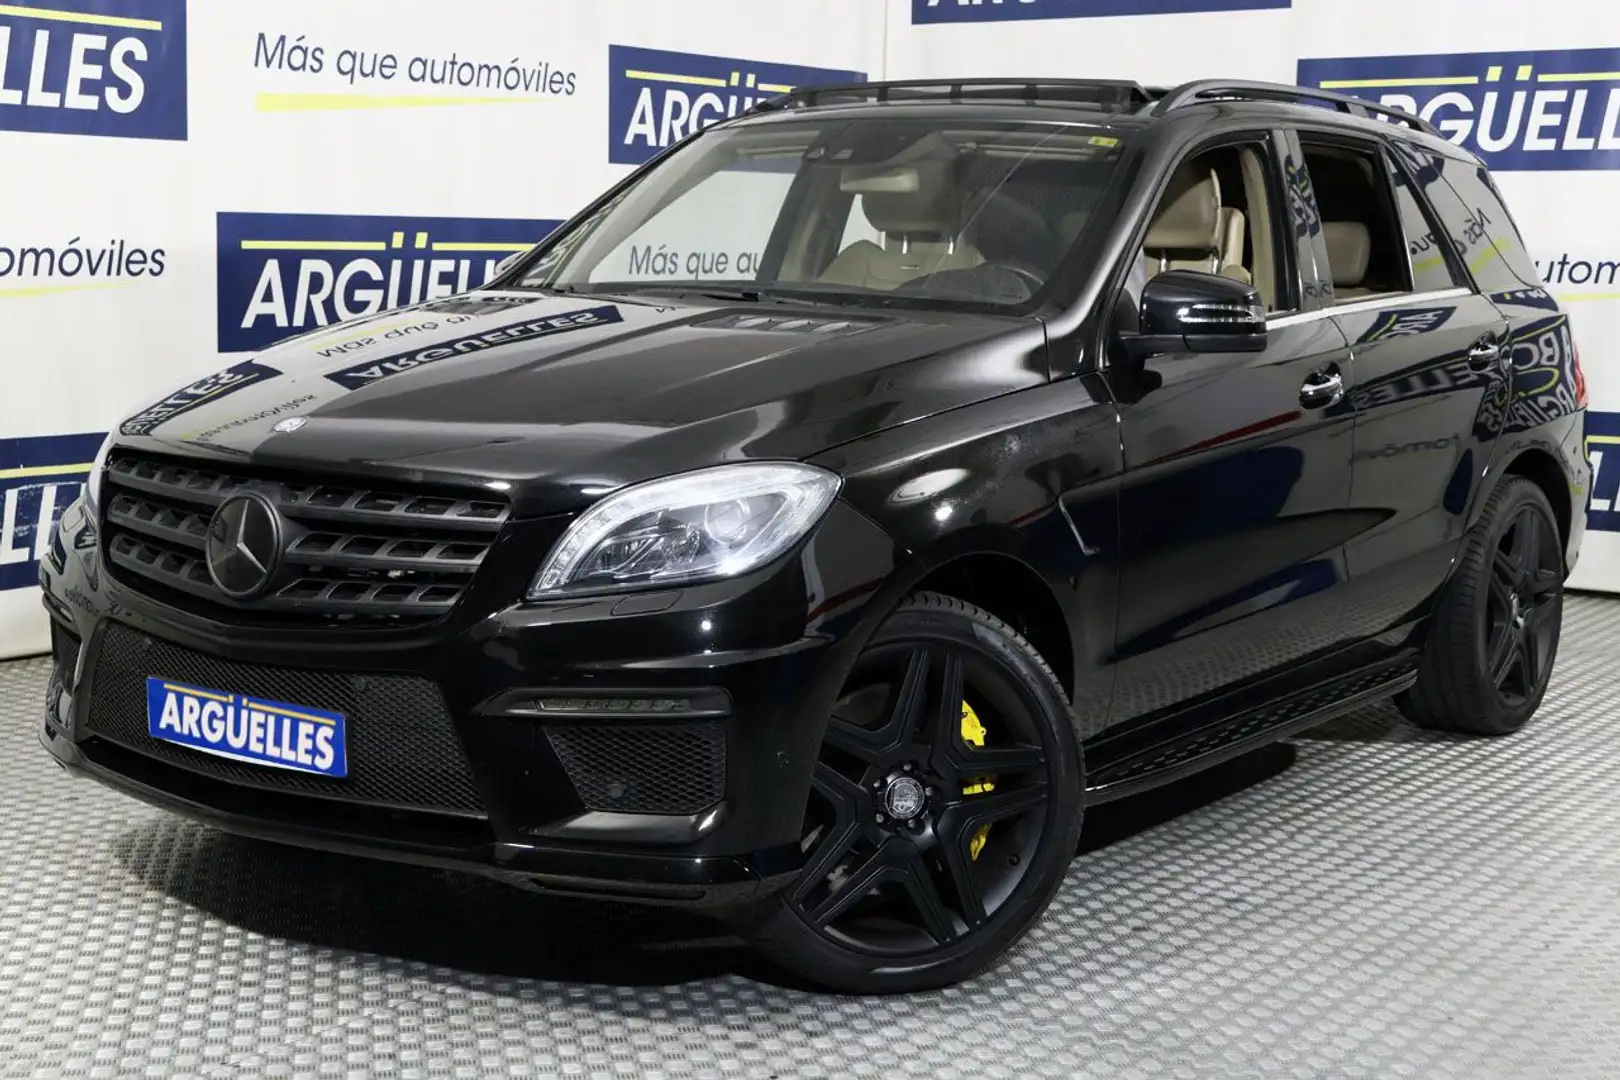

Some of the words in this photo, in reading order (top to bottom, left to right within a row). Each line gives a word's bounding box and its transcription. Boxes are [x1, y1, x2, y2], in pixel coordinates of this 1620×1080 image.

[254, 32, 324, 73] Más
[336, 49, 398, 85] que
[408, 53, 577, 95] automóviles
[629, 244, 679, 275] Más
[686, 251, 729, 280] que
[159, 692, 335, 770] ARGÜELLES
